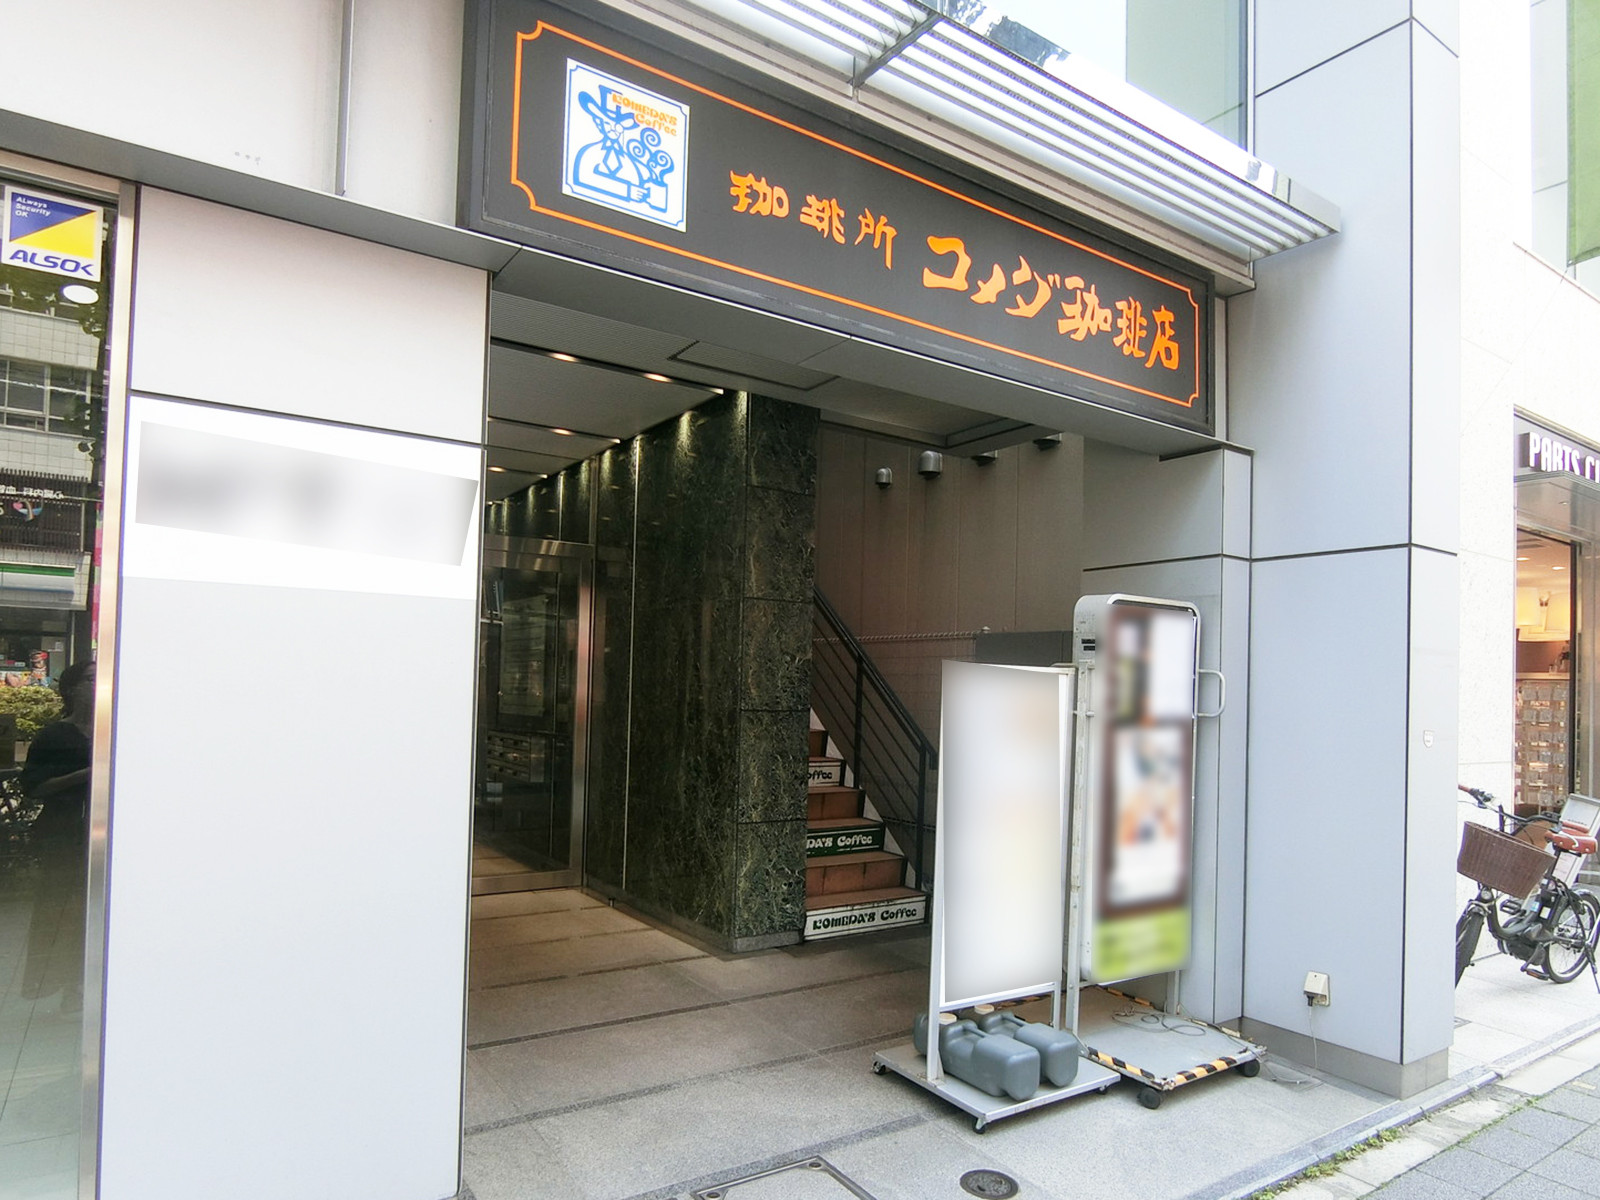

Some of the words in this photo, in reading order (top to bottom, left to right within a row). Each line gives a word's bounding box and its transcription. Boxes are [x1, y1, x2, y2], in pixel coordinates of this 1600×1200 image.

[612, 92, 678, 126] KOMEDA'S
[635, 112, 678, 137] Coffee
[15, 203, 51, 217] Security
[15, 209, 29, 218] OK
[9, 249, 94, 277] ALSOK
[729, 169, 898, 271] 珈琲所
[922, 234, 1180, 370] コメダ珈琲店
[1529, 431, 1581, 476] PARTS
[837, 834, 873, 847] Coffee
[812, 911, 876, 931] KOMEDA'S
[881, 907, 917, 921] Coffee
